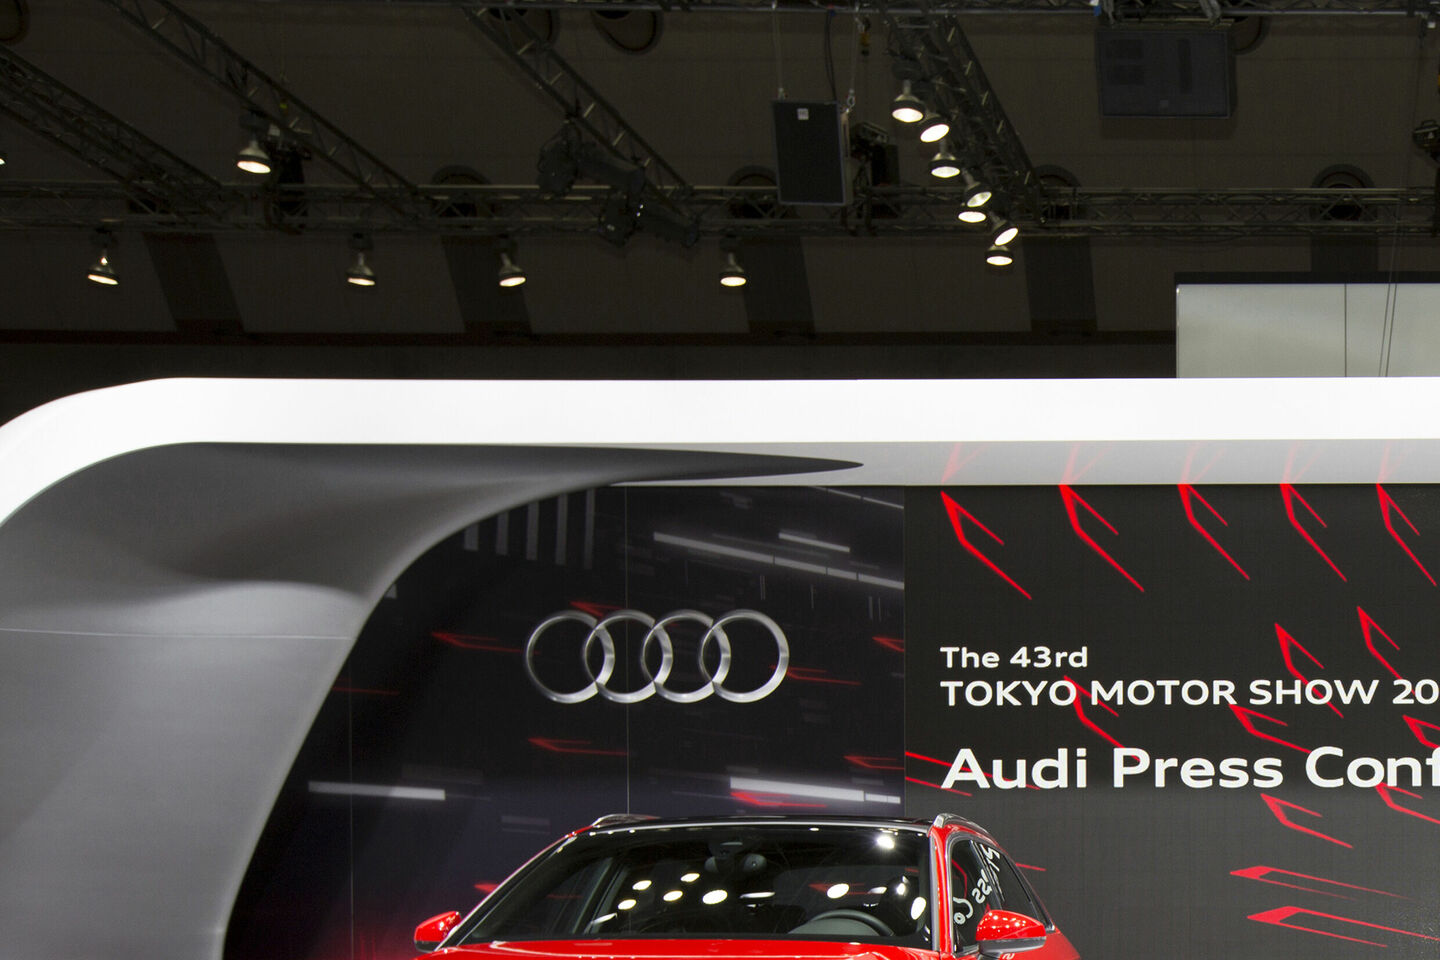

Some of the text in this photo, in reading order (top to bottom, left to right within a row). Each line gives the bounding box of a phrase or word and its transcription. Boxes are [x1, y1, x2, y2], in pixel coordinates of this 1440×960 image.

[939, 645, 1088, 669] The 43rd
[939, 680, 1077, 707] TOKYO
[1090, 679, 1238, 706] MOTOR
[1249, 679, 1380, 705] SHOW
[940, 747, 1088, 790] Audi
[1112, 747, 1284, 789] Press
